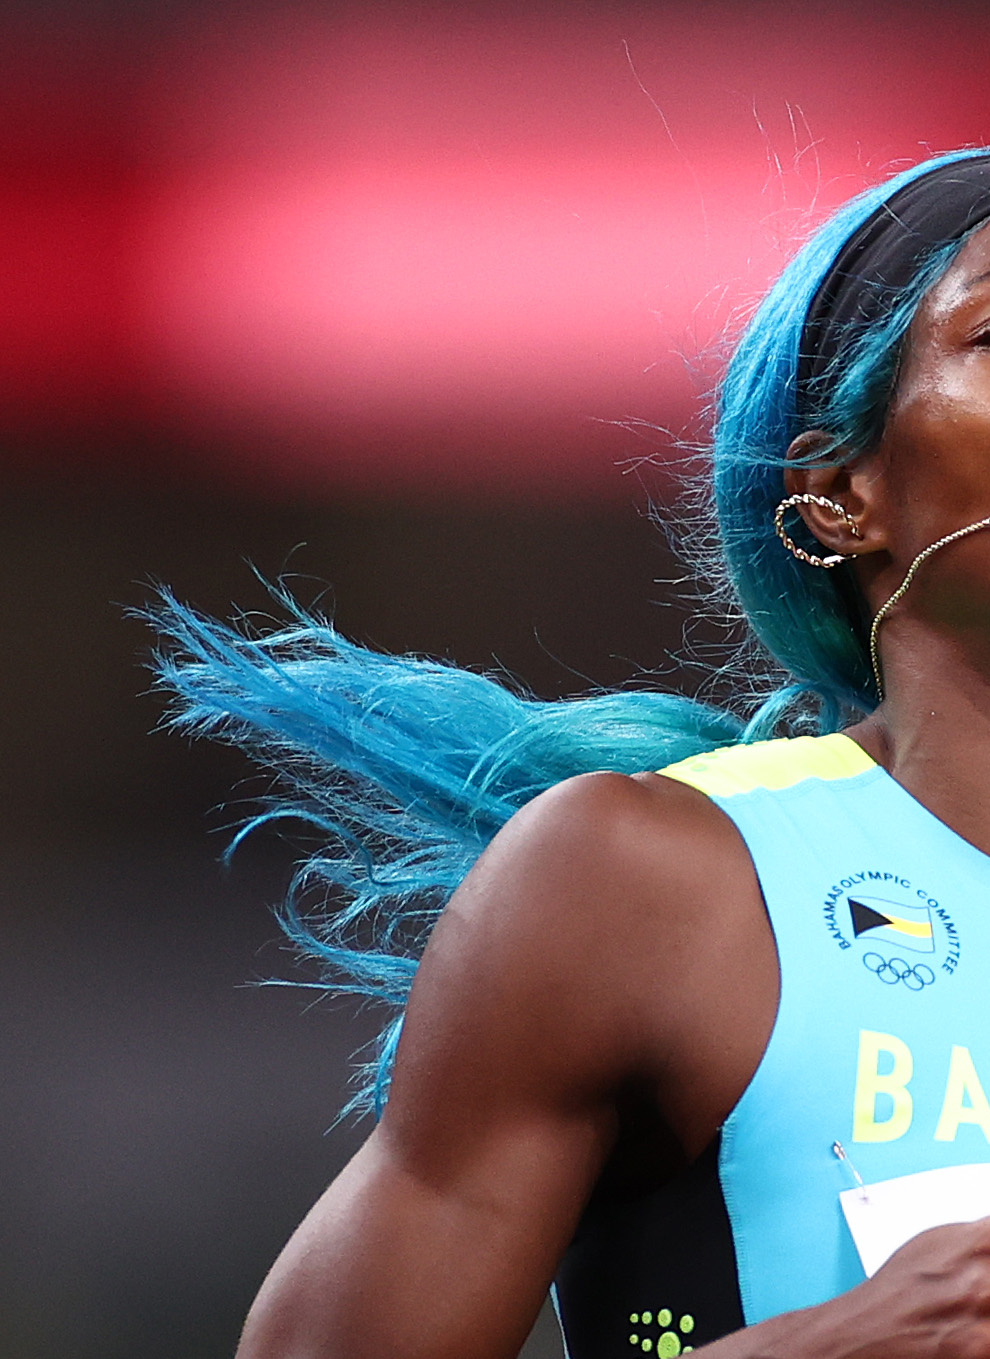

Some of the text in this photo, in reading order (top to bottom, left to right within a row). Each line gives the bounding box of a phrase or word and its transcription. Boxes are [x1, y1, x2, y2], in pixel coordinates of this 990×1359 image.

[823, 871, 960, 975] BAHAMAS OLYMPIC COMMITTEE
